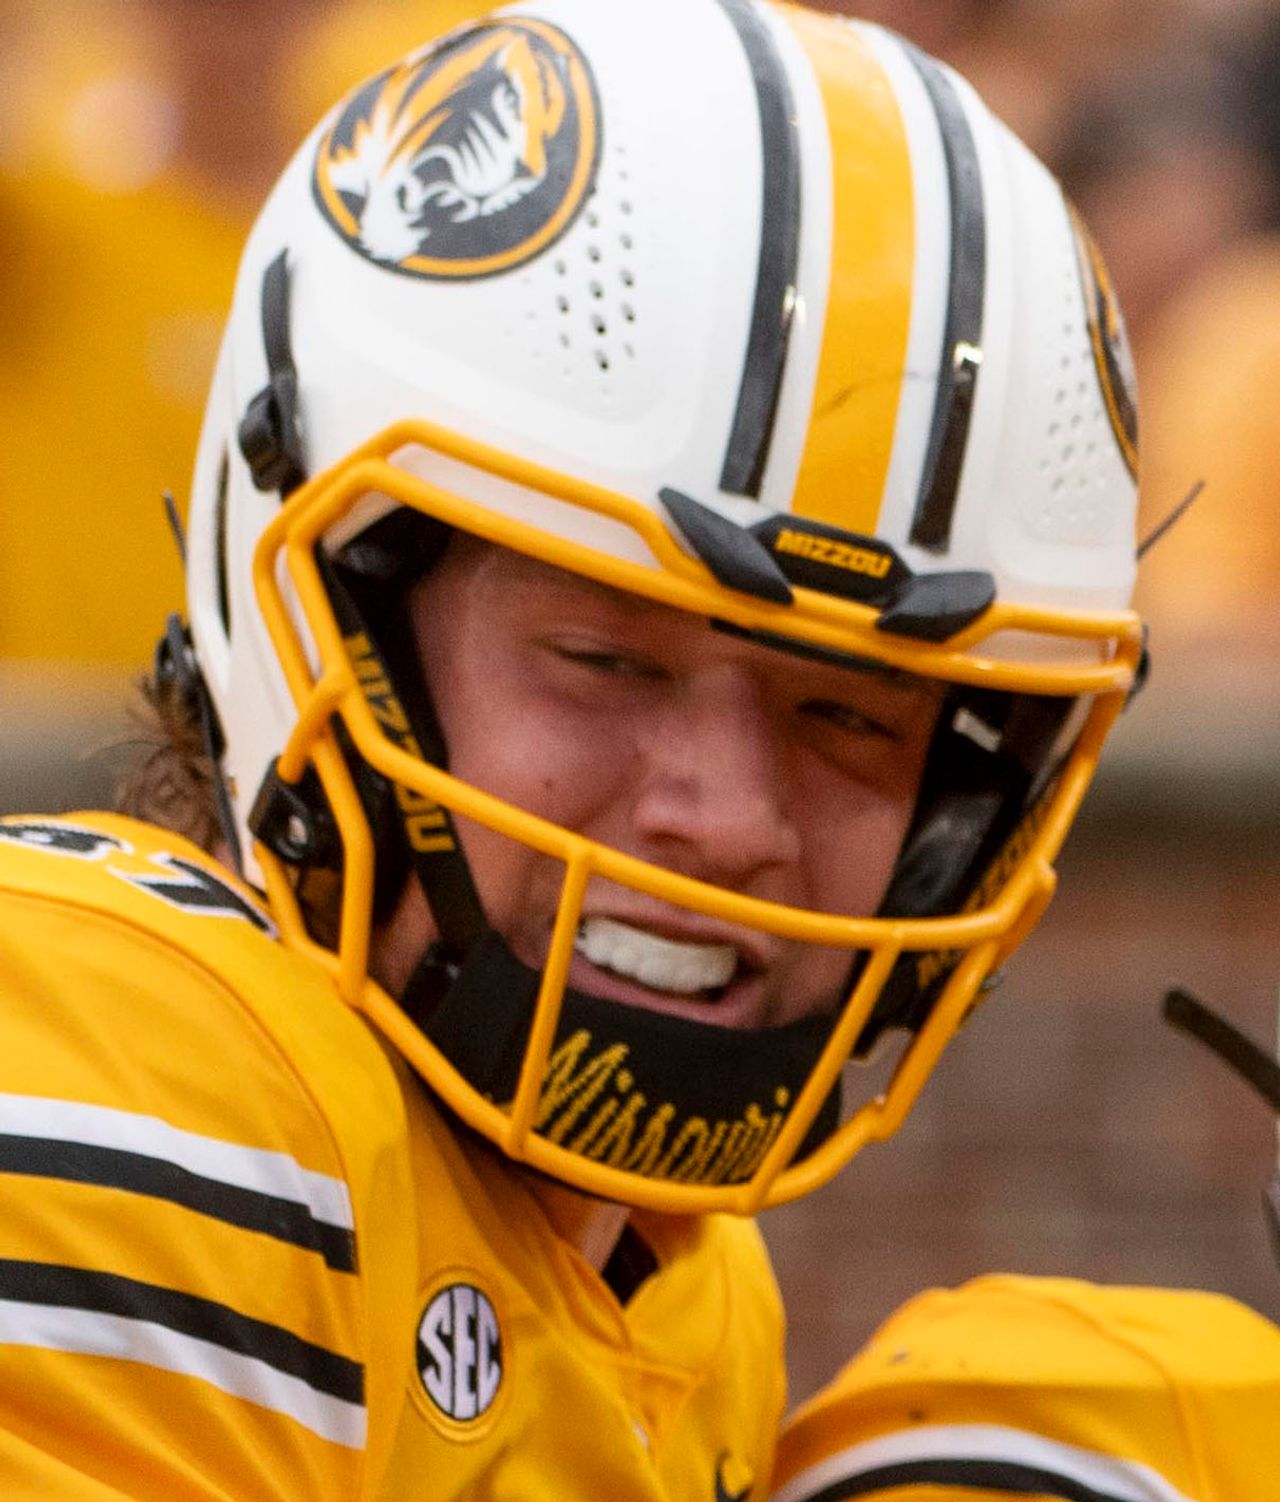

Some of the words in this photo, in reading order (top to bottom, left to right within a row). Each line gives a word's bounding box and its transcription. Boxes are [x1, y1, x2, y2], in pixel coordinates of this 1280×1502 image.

[774, 528, 893, 579] MIZZOU
[492, 1028, 792, 1187] Missouri
[417, 1284, 502, 1418] SEC
